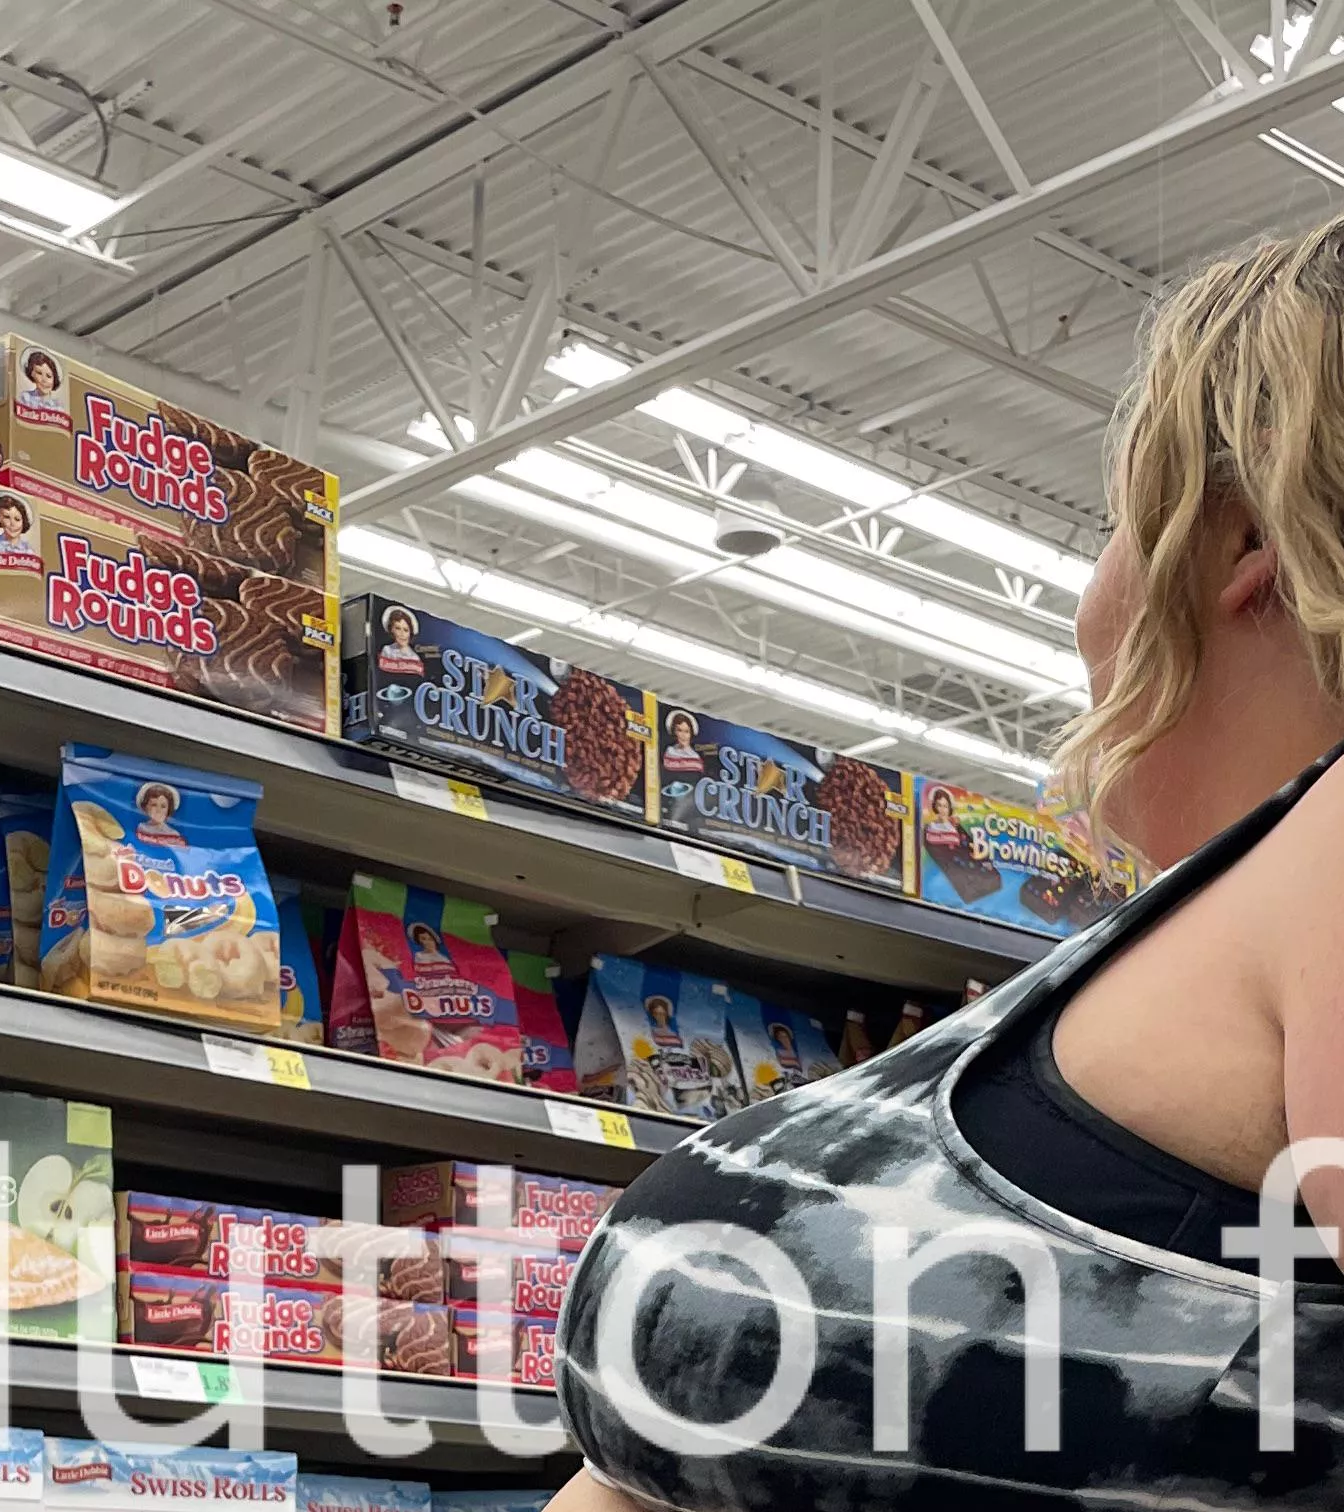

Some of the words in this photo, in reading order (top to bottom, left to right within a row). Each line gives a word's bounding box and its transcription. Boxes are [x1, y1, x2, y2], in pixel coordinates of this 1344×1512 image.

[85, 392, 215, 478] Fudge
[75, 433, 229, 523] Rounds
[59, 533, 199, 612] Fudge
[48, 574, 217, 656] Rounds
[413, 680, 566, 768] CRUNCH
[695, 777, 832, 849] CRUNCH
[982, 813, 1058, 849] Cosmic
[969, 826, 1071, 875] Brownies
[268, 1050, 305, 1079] 2.16
[600, 1116, 628, 1139] 2.16
[523, 1180, 598, 1215] Fudge
[218, 1213, 307, 1249] Fudge
[222, 1291, 312, 1330] Fudge
[130, 1472, 206, 1498] SWISS
[214, 1477, 286, 1502] ROLLS
